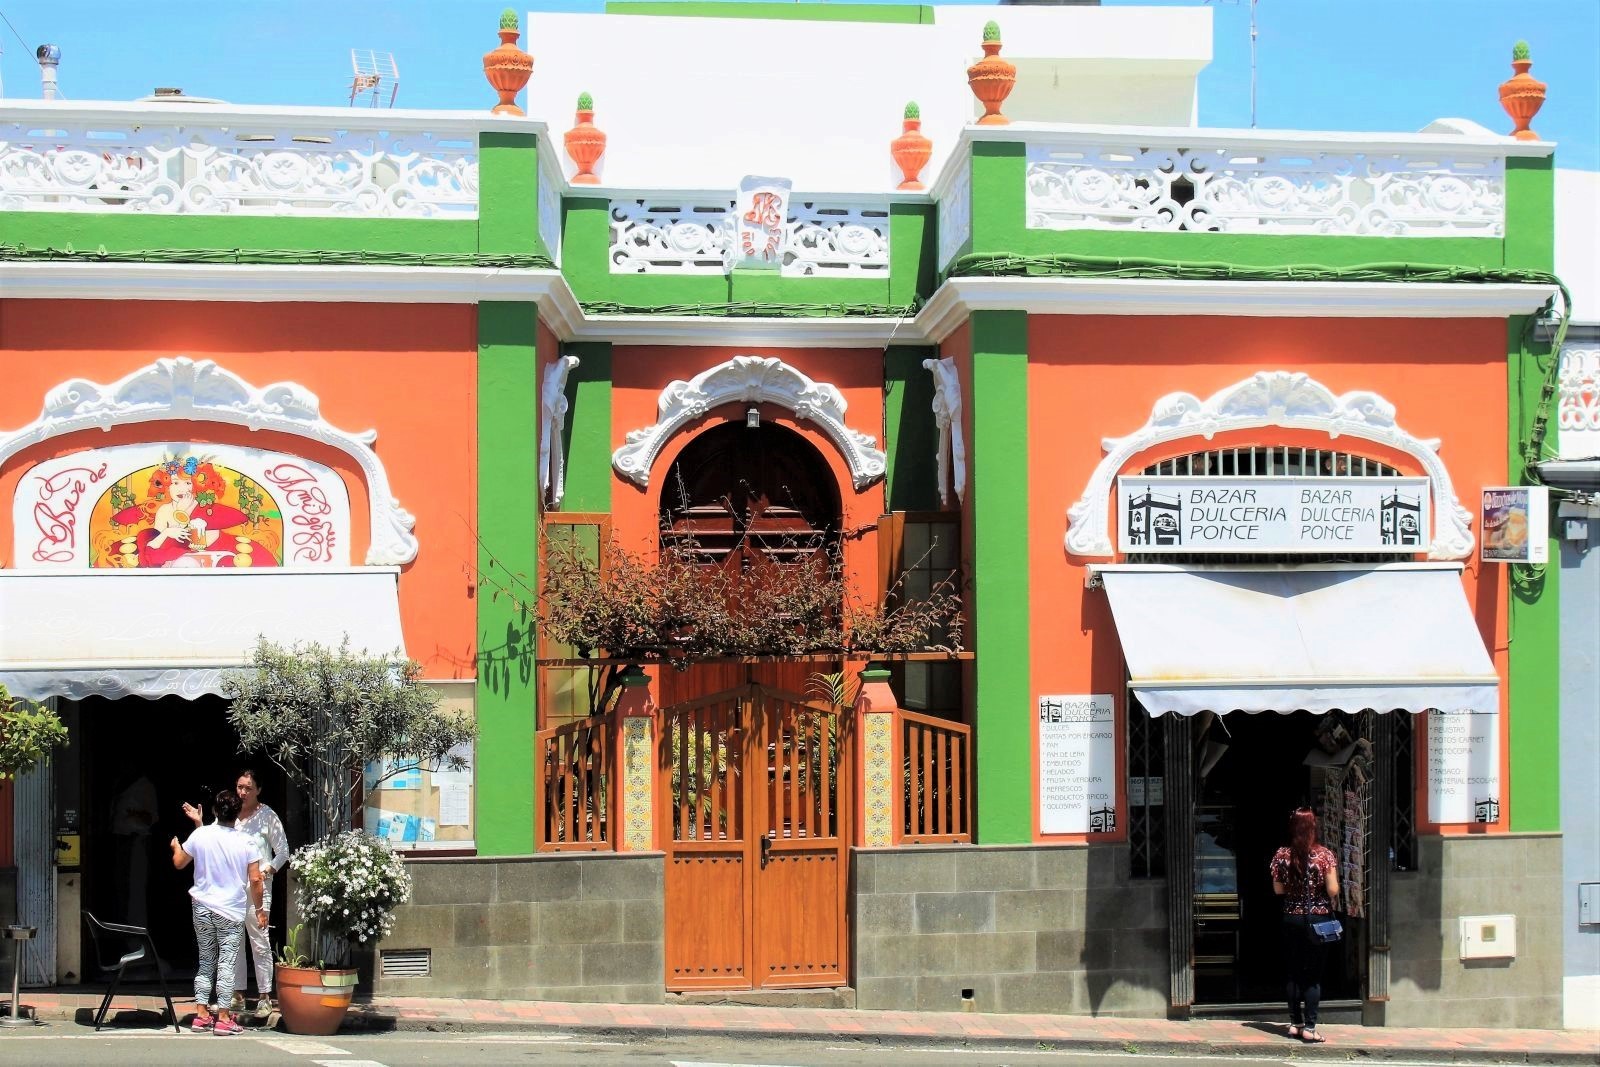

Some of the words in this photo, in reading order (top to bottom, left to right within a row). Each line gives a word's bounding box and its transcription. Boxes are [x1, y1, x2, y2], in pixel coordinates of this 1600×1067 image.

[1190, 489, 1256, 504] BAZAR
[1301, 489, 1352, 504] BAZAR
[264, 463, 336, 562] Amigos
[1190, 507, 1287, 522] DULCERIA
[1301, 507, 1375, 522] DULCERIA
[1190, 525, 1260, 540] PONCE
[1301, 525, 1354, 540] PONCE
[182, 669, 223, 696] Tilo
